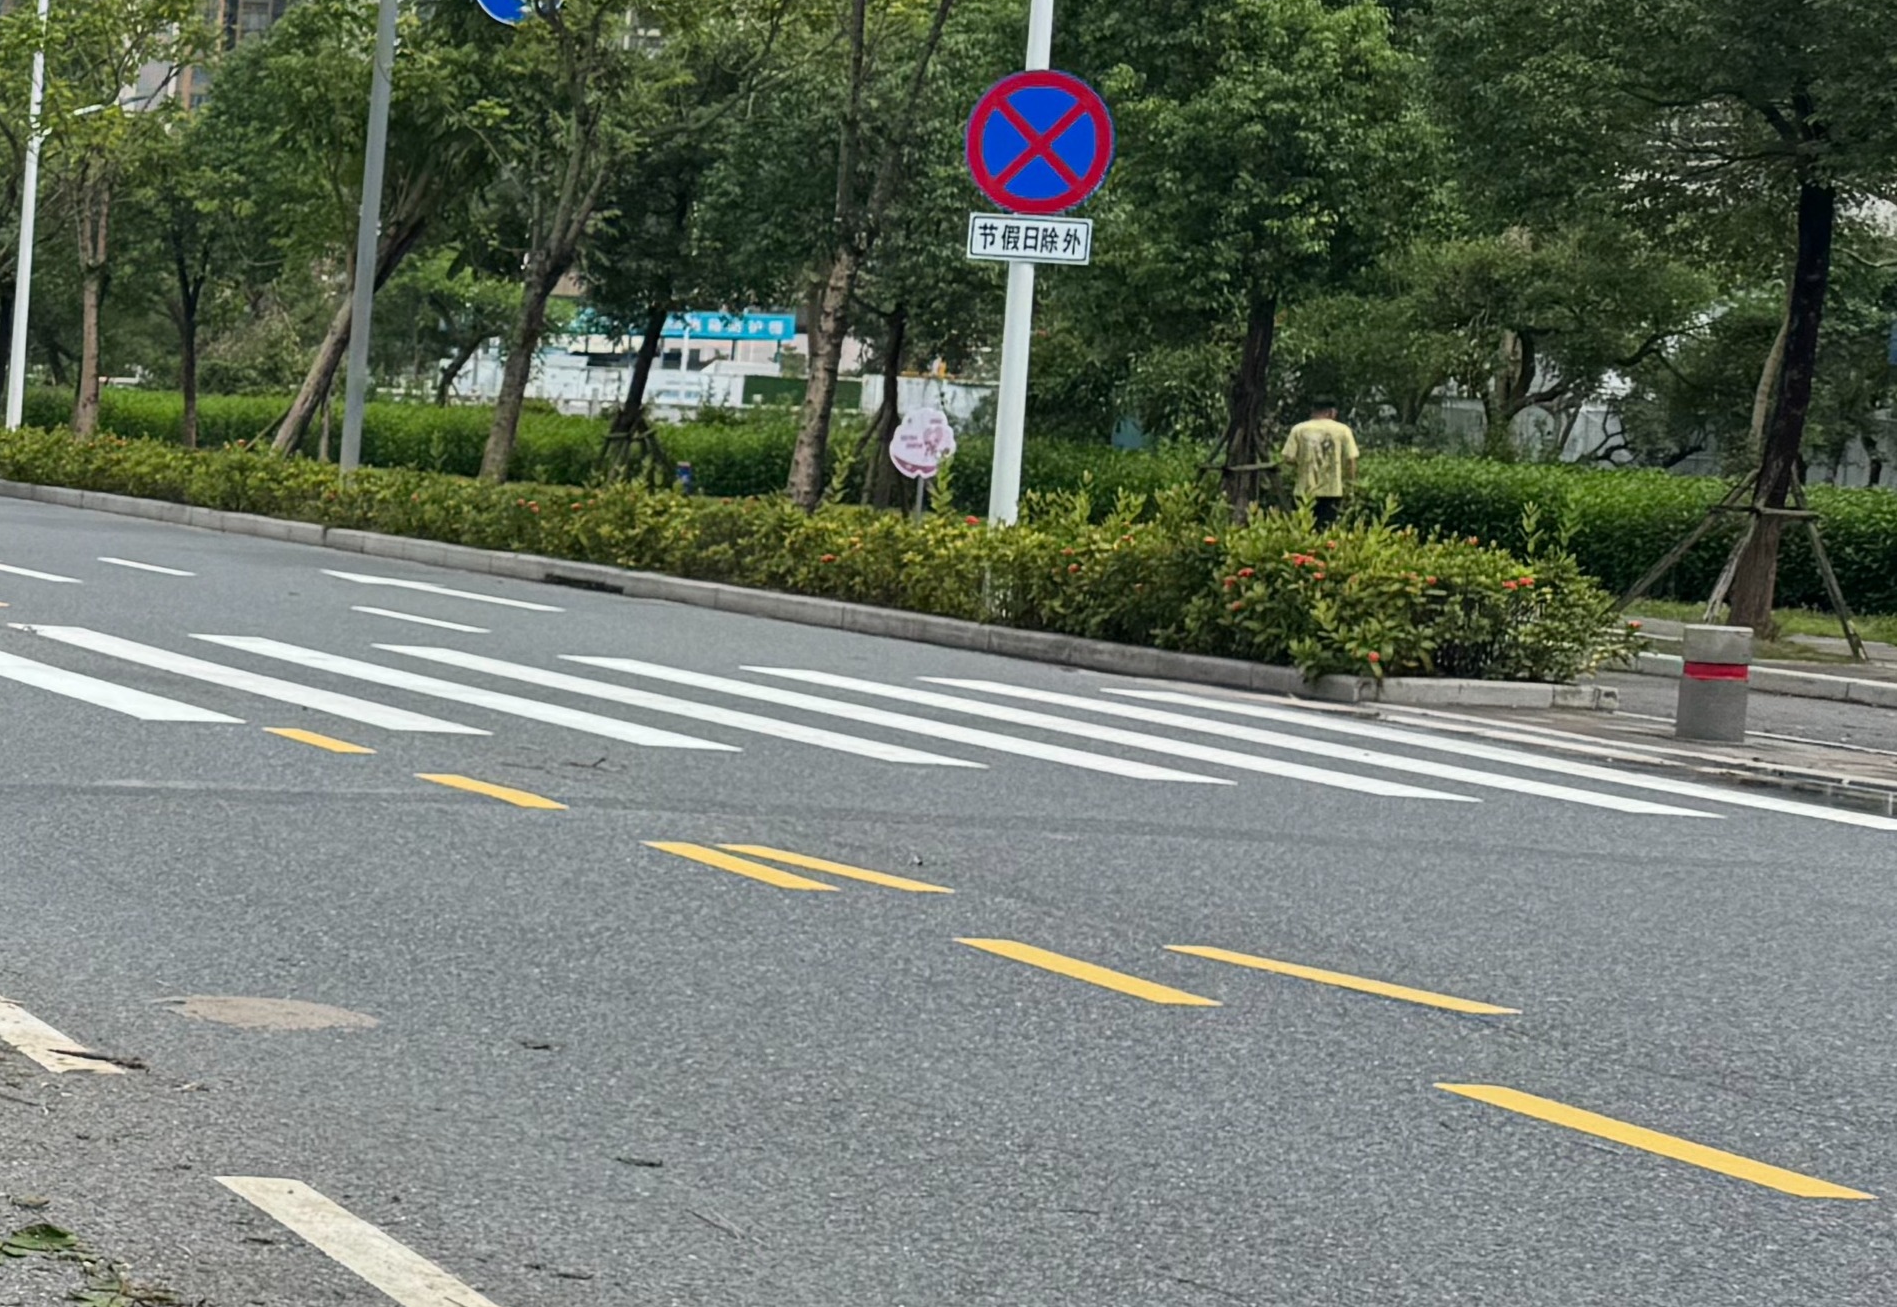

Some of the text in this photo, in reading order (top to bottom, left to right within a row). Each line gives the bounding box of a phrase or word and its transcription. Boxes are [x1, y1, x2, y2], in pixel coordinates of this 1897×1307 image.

[978, 223, 1081, 255] 节假日除外
